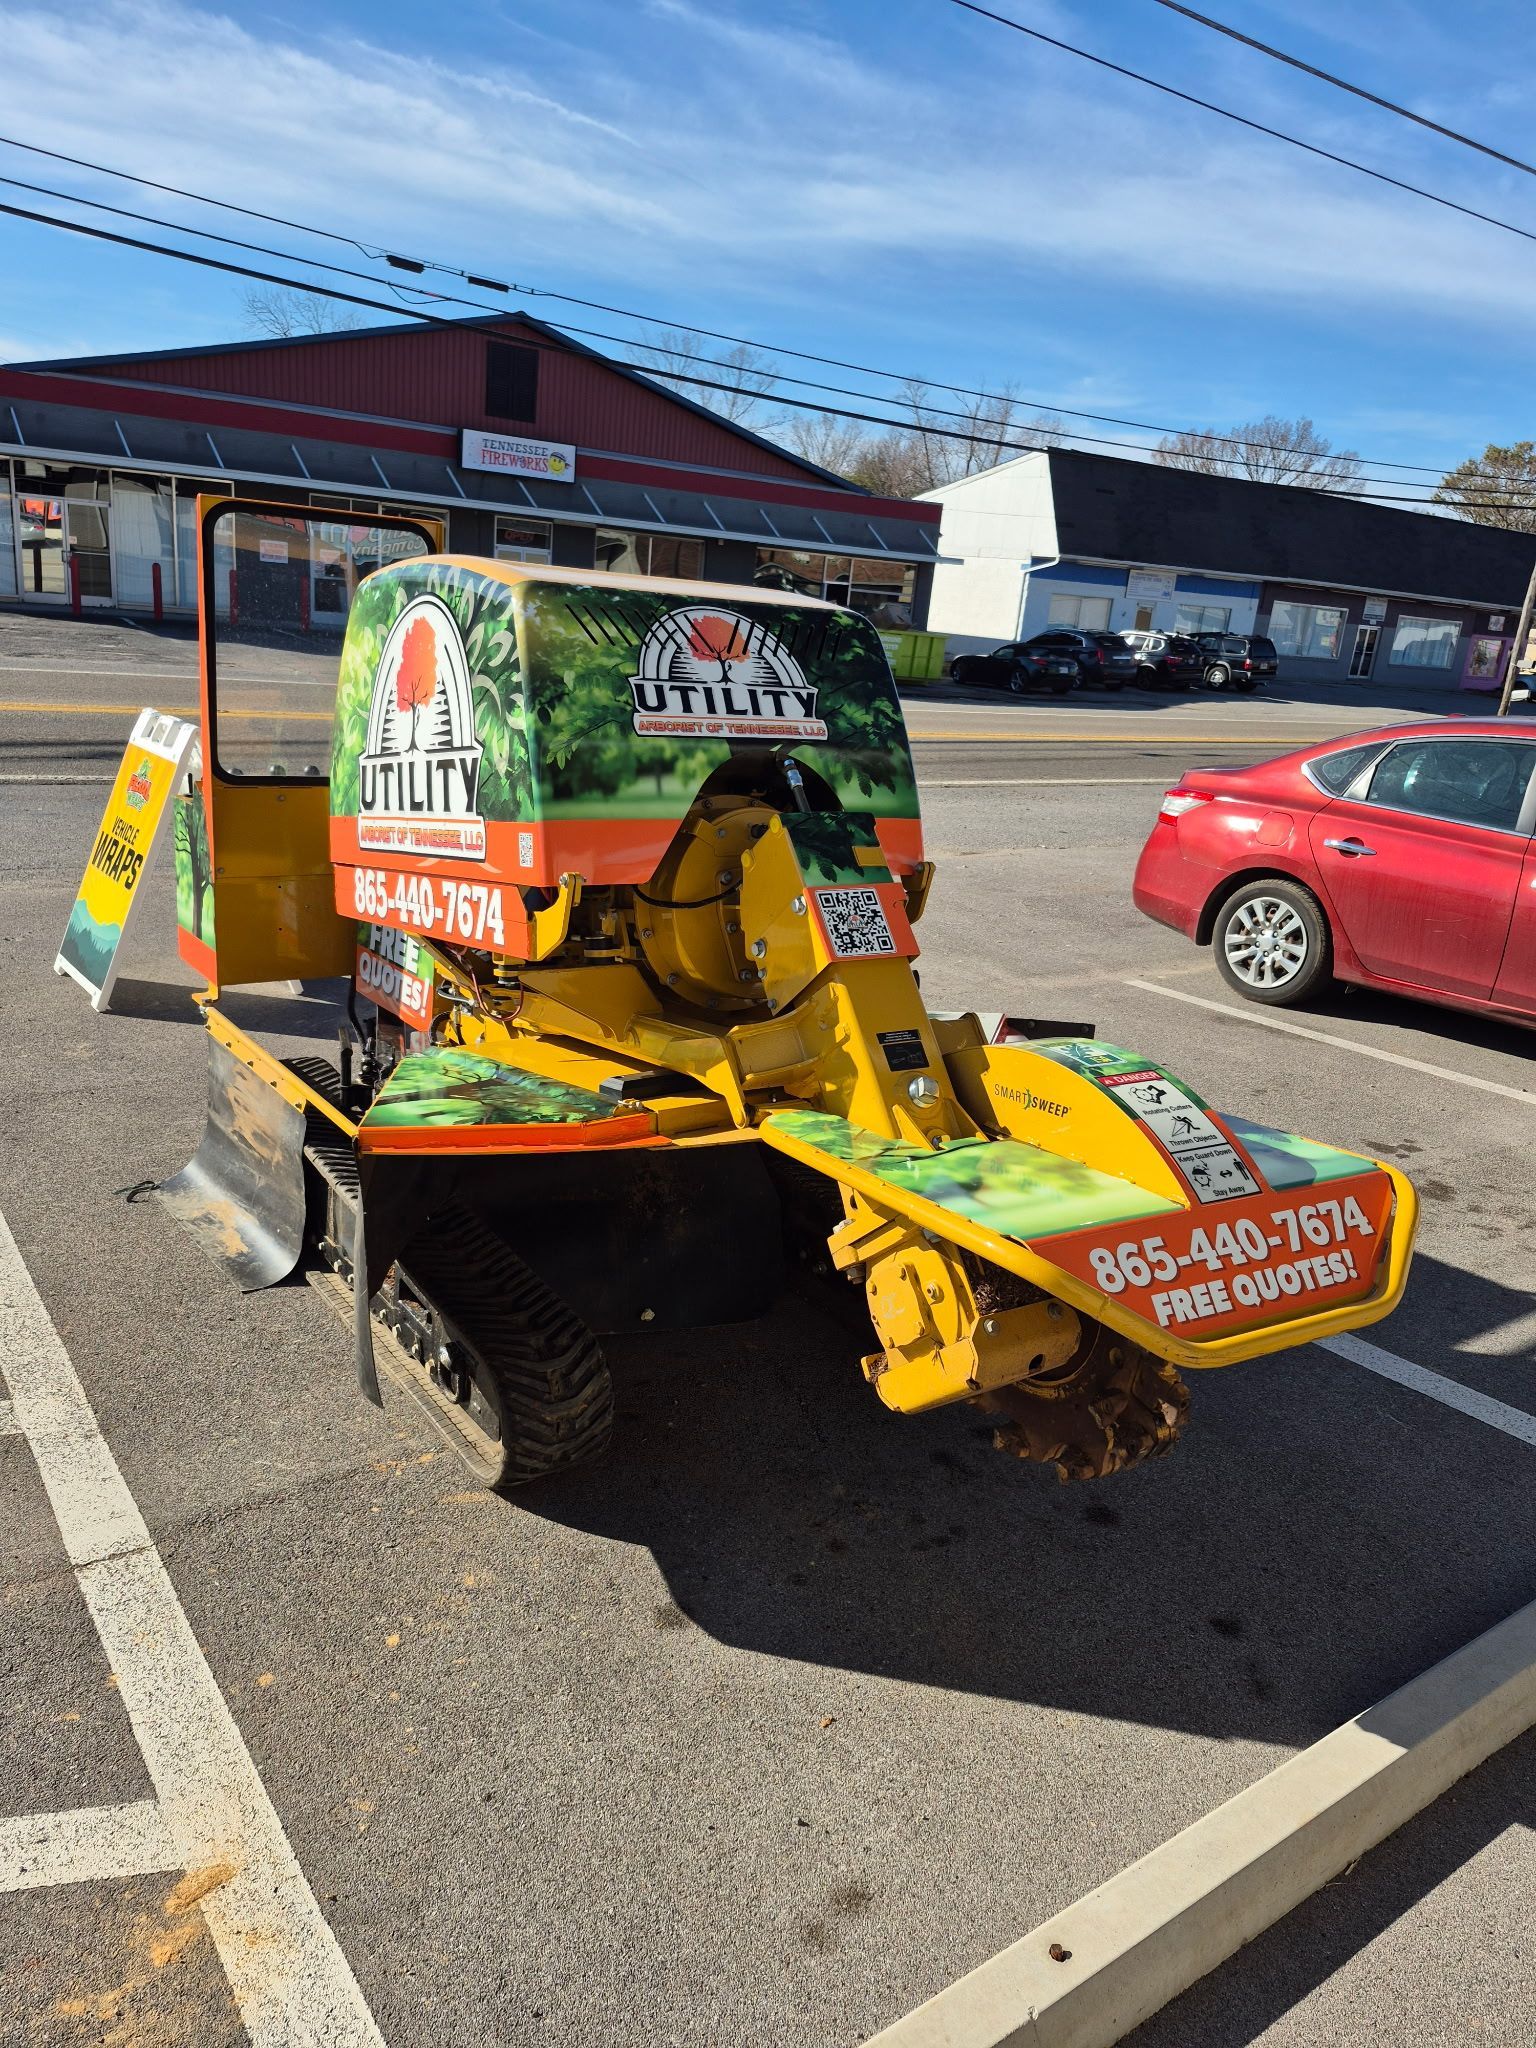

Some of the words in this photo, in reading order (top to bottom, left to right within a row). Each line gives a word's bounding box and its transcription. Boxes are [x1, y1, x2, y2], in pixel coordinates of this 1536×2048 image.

[481, 449, 549, 473] FIREWORKS
[482, 438, 548, 457] TENNESSEE
[634, 683, 816, 718] UTILITY
[638, 720, 704, 733] ARBORIST
[706, 722, 724, 733] OF
[725, 723, 803, 737] TENNESSEE,
[803, 726, 826, 737] LLC
[361, 757, 479, 812] UTILITY
[111, 815, 140, 846] VEHICLE
[361, 826, 396, 843] ARBORIST
[397, 826, 408, 845] OF
[409, 827, 464, 851] TENNESSEE,
[464, 830, 484, 851] LLC
[91, 830, 144, 890] WRAPS
[354, 867, 505, 946] 865-440-7674
[369, 923, 420, 976] FREE
[359, 951, 431, 1018] QUOTES!
[1113, 1071, 1162, 1083] DANGER
[1142, 1106, 1170, 1117] Rotating
[1170, 1104, 1193, 1113] Cutters
[1168, 1138, 1194, 1147] Thrown
[1193, 1134, 1218, 1144] Objects
[1177, 1154, 1195, 1164] Keep
[1194, 1151, 1215, 1160] Guard
[1215, 1148, 1233, 1157] Down
[1212, 1188, 1228, 1198] Stay
[1228, 1185, 1246, 1195] Away
[1088, 1195, 1376, 1294] 865-440-7674
[1151, 1279, 1234, 1328] FREE
[1231, 1248, 1359, 1308] QUOTES!
